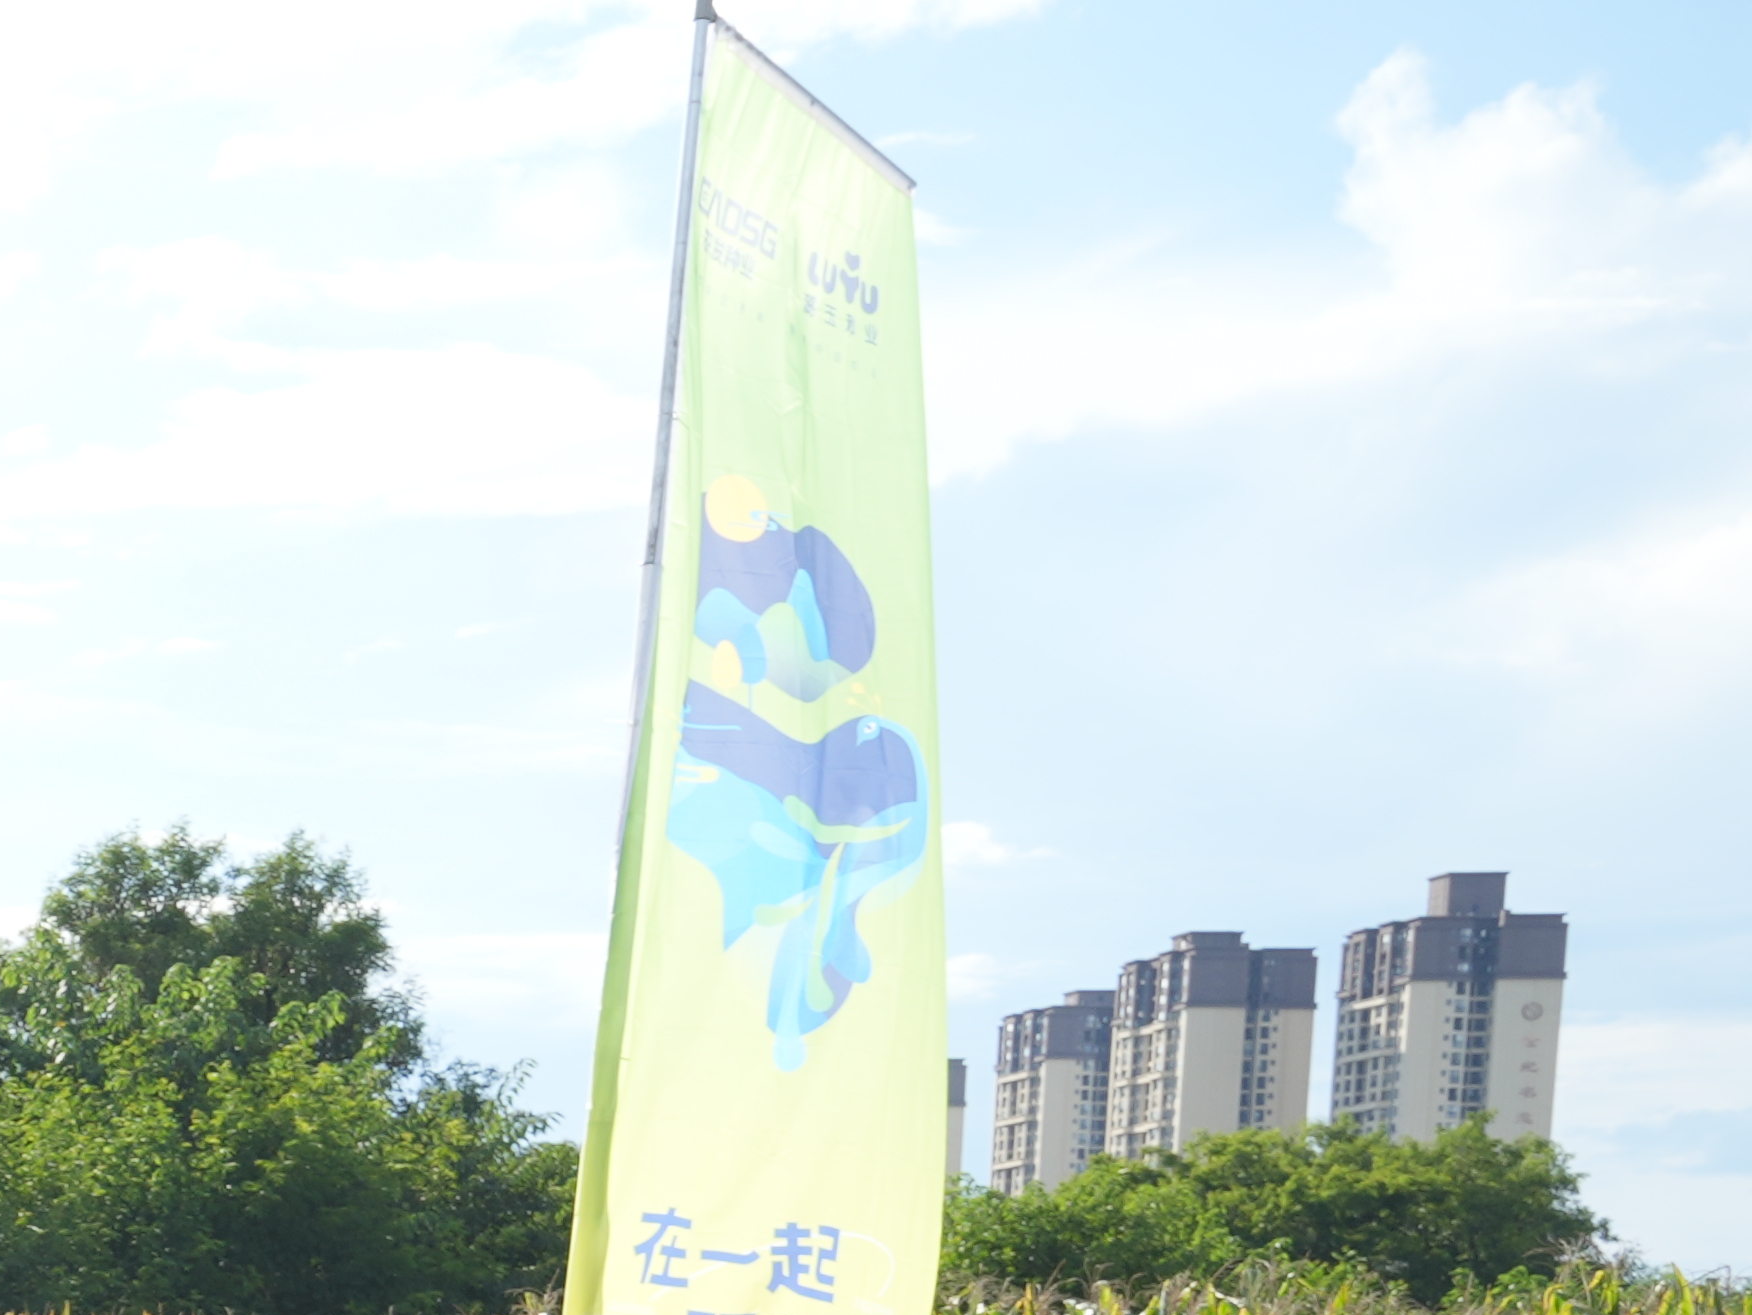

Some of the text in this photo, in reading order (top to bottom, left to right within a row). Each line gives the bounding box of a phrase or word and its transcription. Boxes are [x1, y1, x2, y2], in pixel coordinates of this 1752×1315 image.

[808, 251, 879, 314] LUYU
[633, 1207, 841, 1303] 在一起
